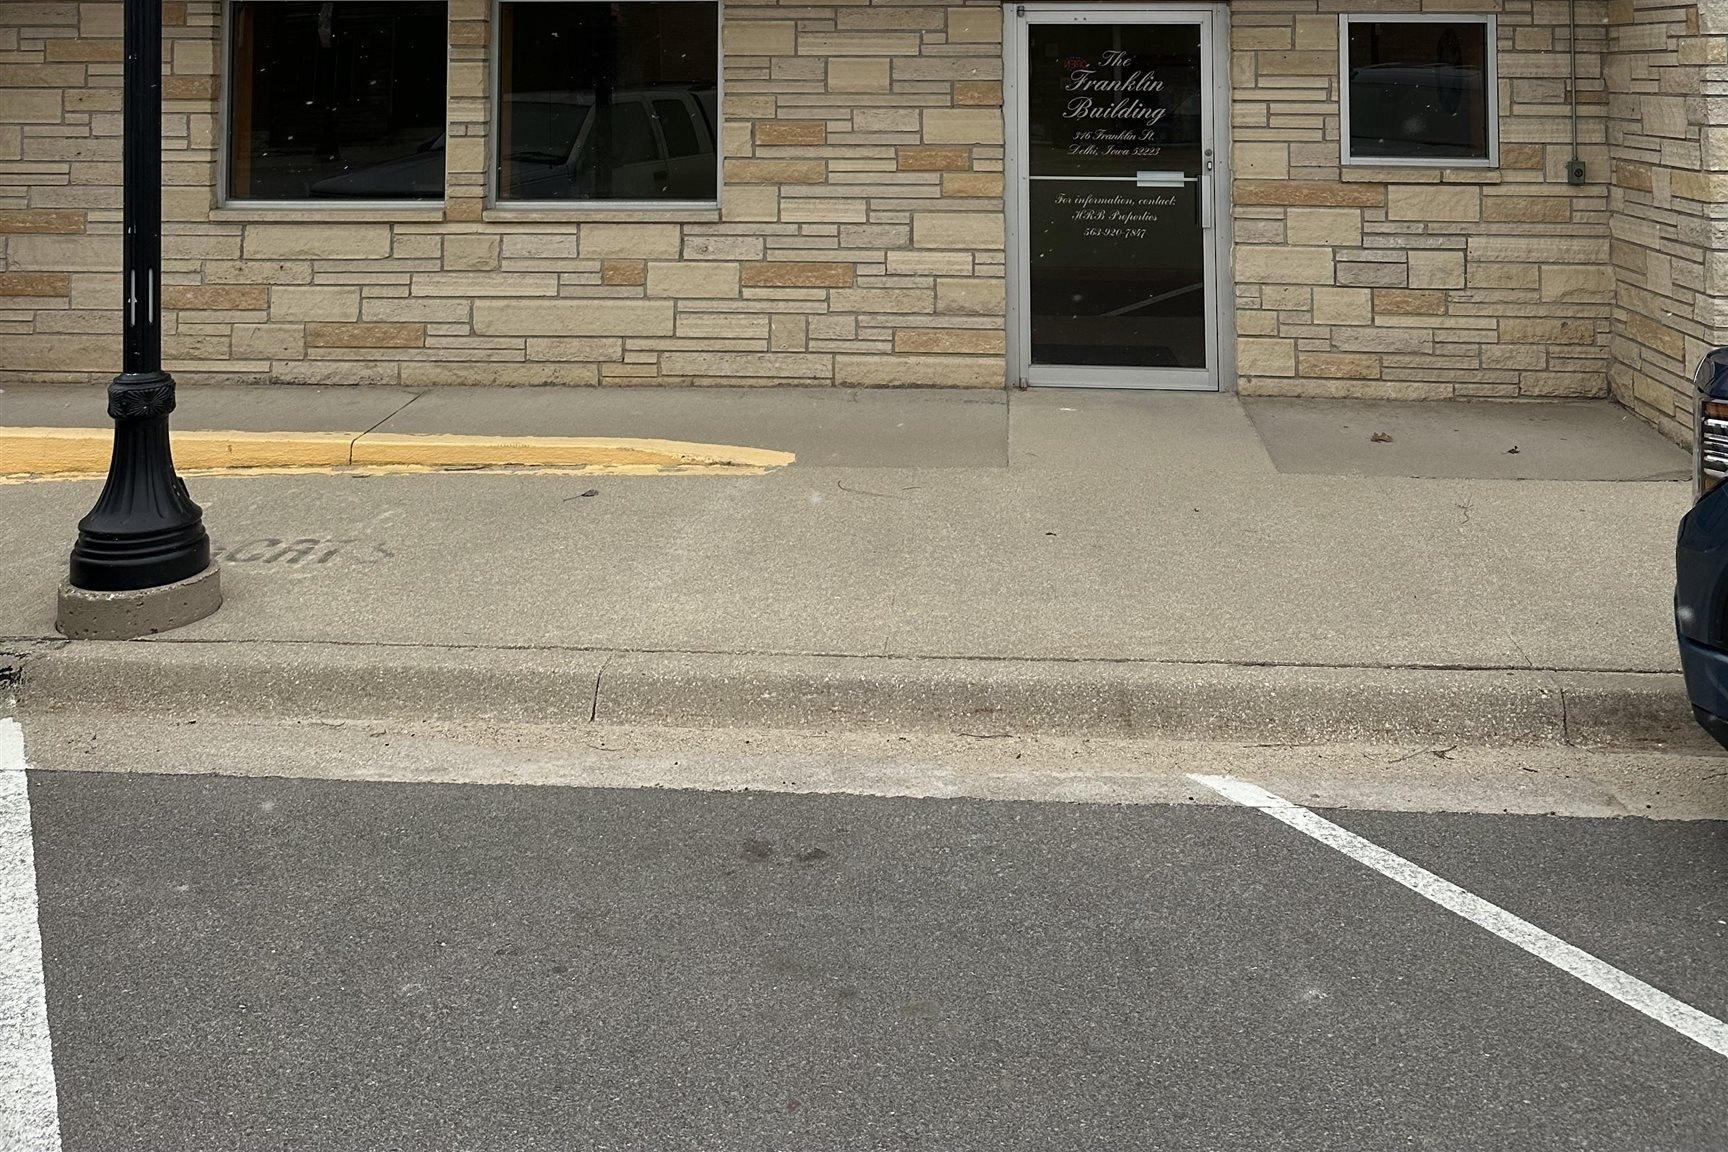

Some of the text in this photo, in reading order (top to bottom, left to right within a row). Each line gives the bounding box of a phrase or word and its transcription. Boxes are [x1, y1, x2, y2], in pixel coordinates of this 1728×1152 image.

[1098, 50, 1132, 67] The
[1065, 69, 1165, 92] Franklin
[1062, 96, 1167, 126] Building
[1092, 129, 1137, 140] Franklin
[1138, 129, 1155, 141] St.
[1067, 144, 1098, 156] Delhi,
[1101, 145, 1130, 155] Iowa
[1055, 193, 1176, 208] For information, contact:
[1108, 211, 1158, 224] Properties
